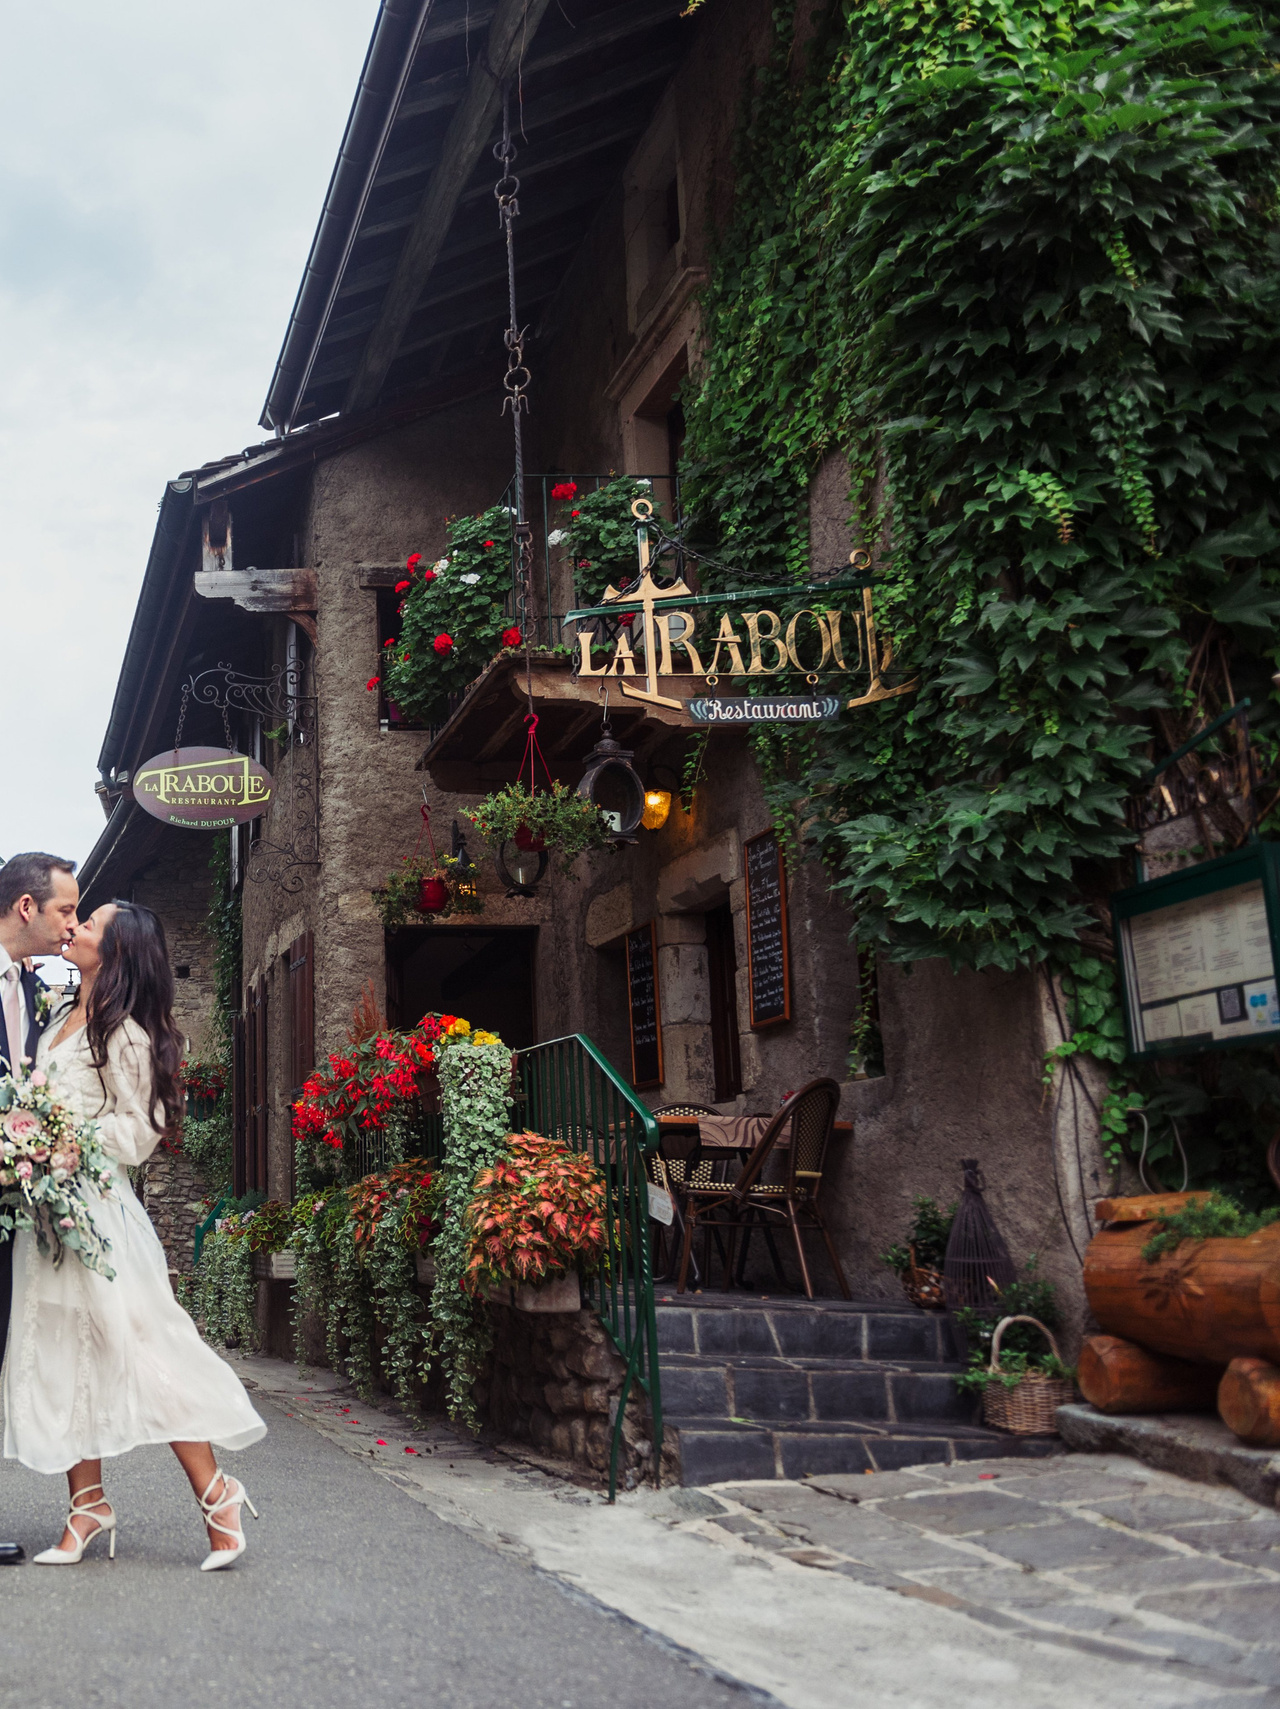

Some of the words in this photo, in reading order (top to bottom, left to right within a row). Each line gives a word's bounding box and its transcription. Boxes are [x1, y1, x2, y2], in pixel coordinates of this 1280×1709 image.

[577, 632, 638, 677] LA
[620, 578, 921, 711] TRABOUL
[708, 699, 822, 720] Restaurant
[144, 783, 159, 792] LA
[171, 797, 237, 806] RESTAURANT
[170, 815, 199, 827] Richard
[200, 817, 236, 827] DUFOUR
